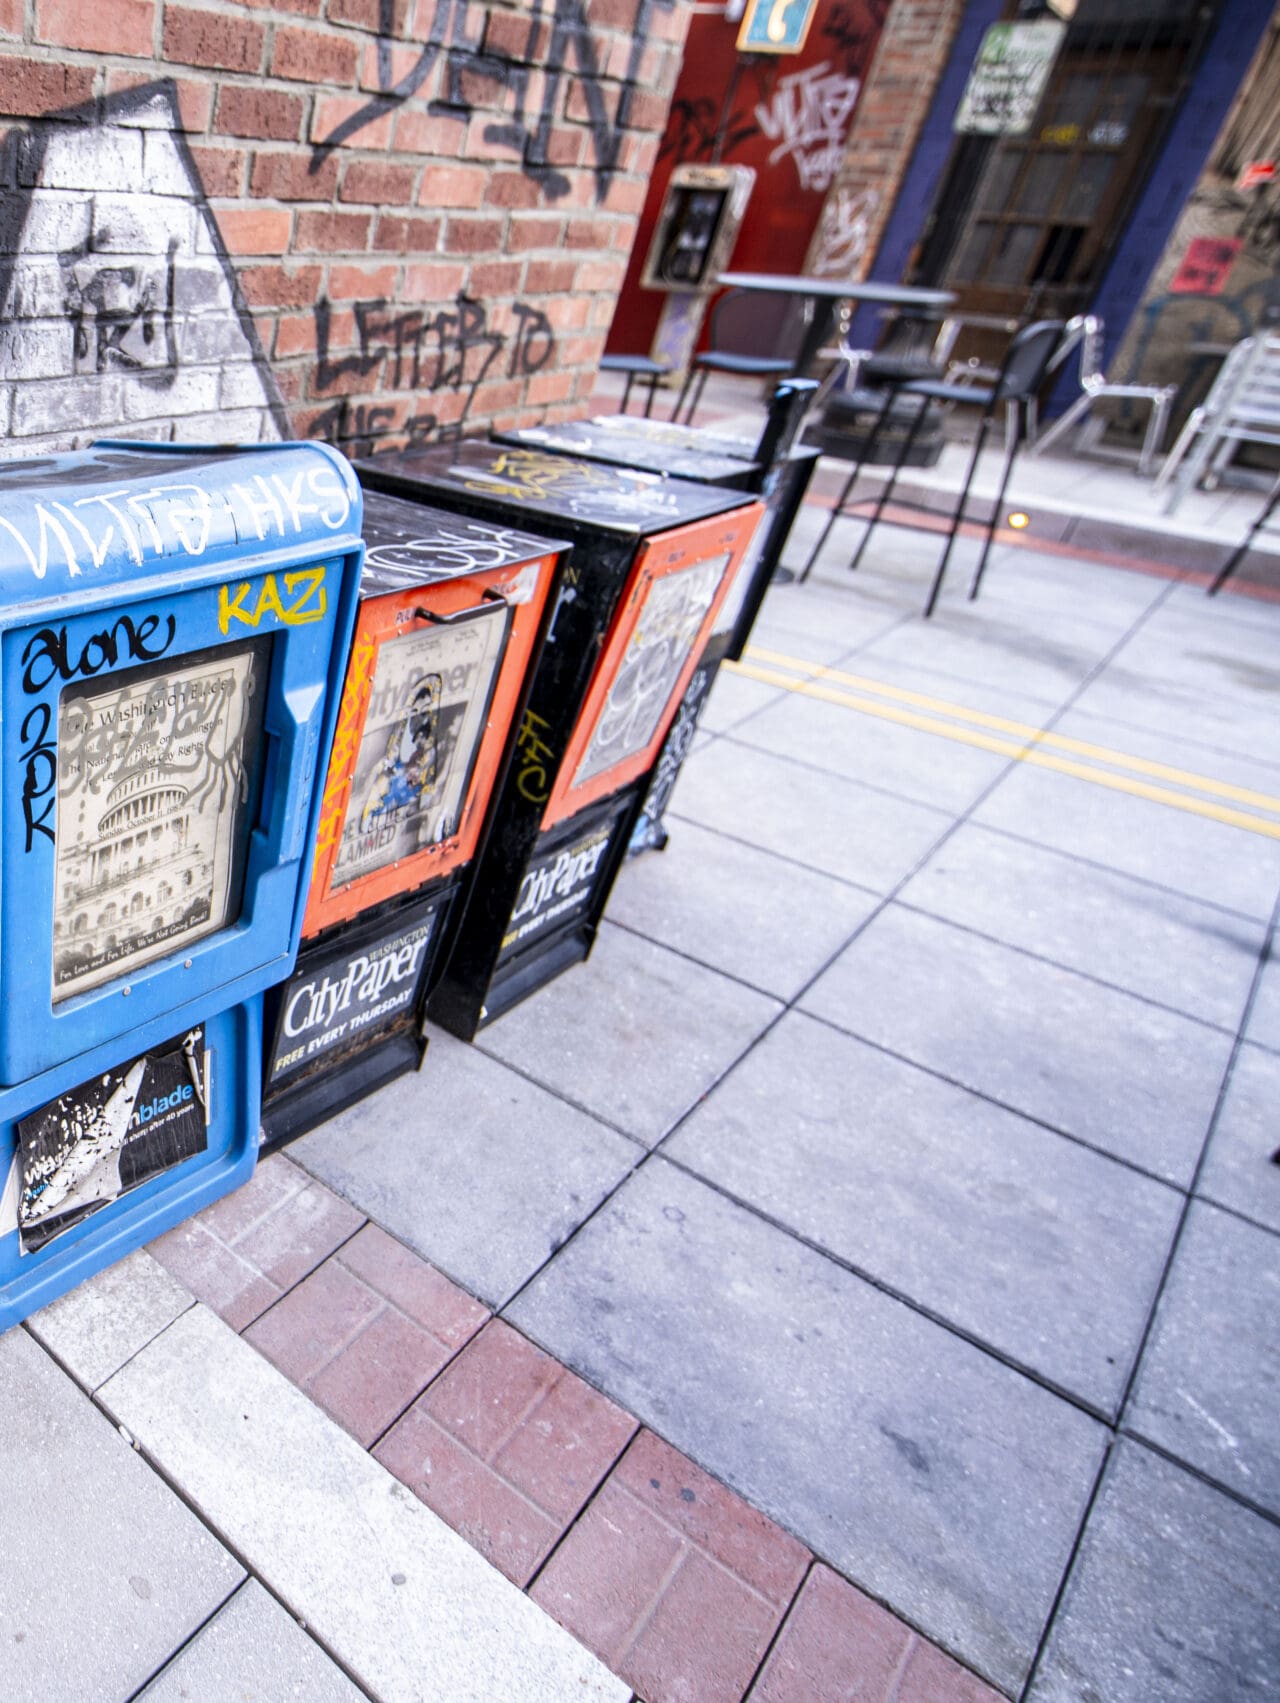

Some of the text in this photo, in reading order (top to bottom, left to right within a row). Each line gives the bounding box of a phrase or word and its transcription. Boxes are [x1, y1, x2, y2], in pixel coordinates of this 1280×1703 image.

[275, 987, 413, 1073] FREE EVERY THURSDAY
